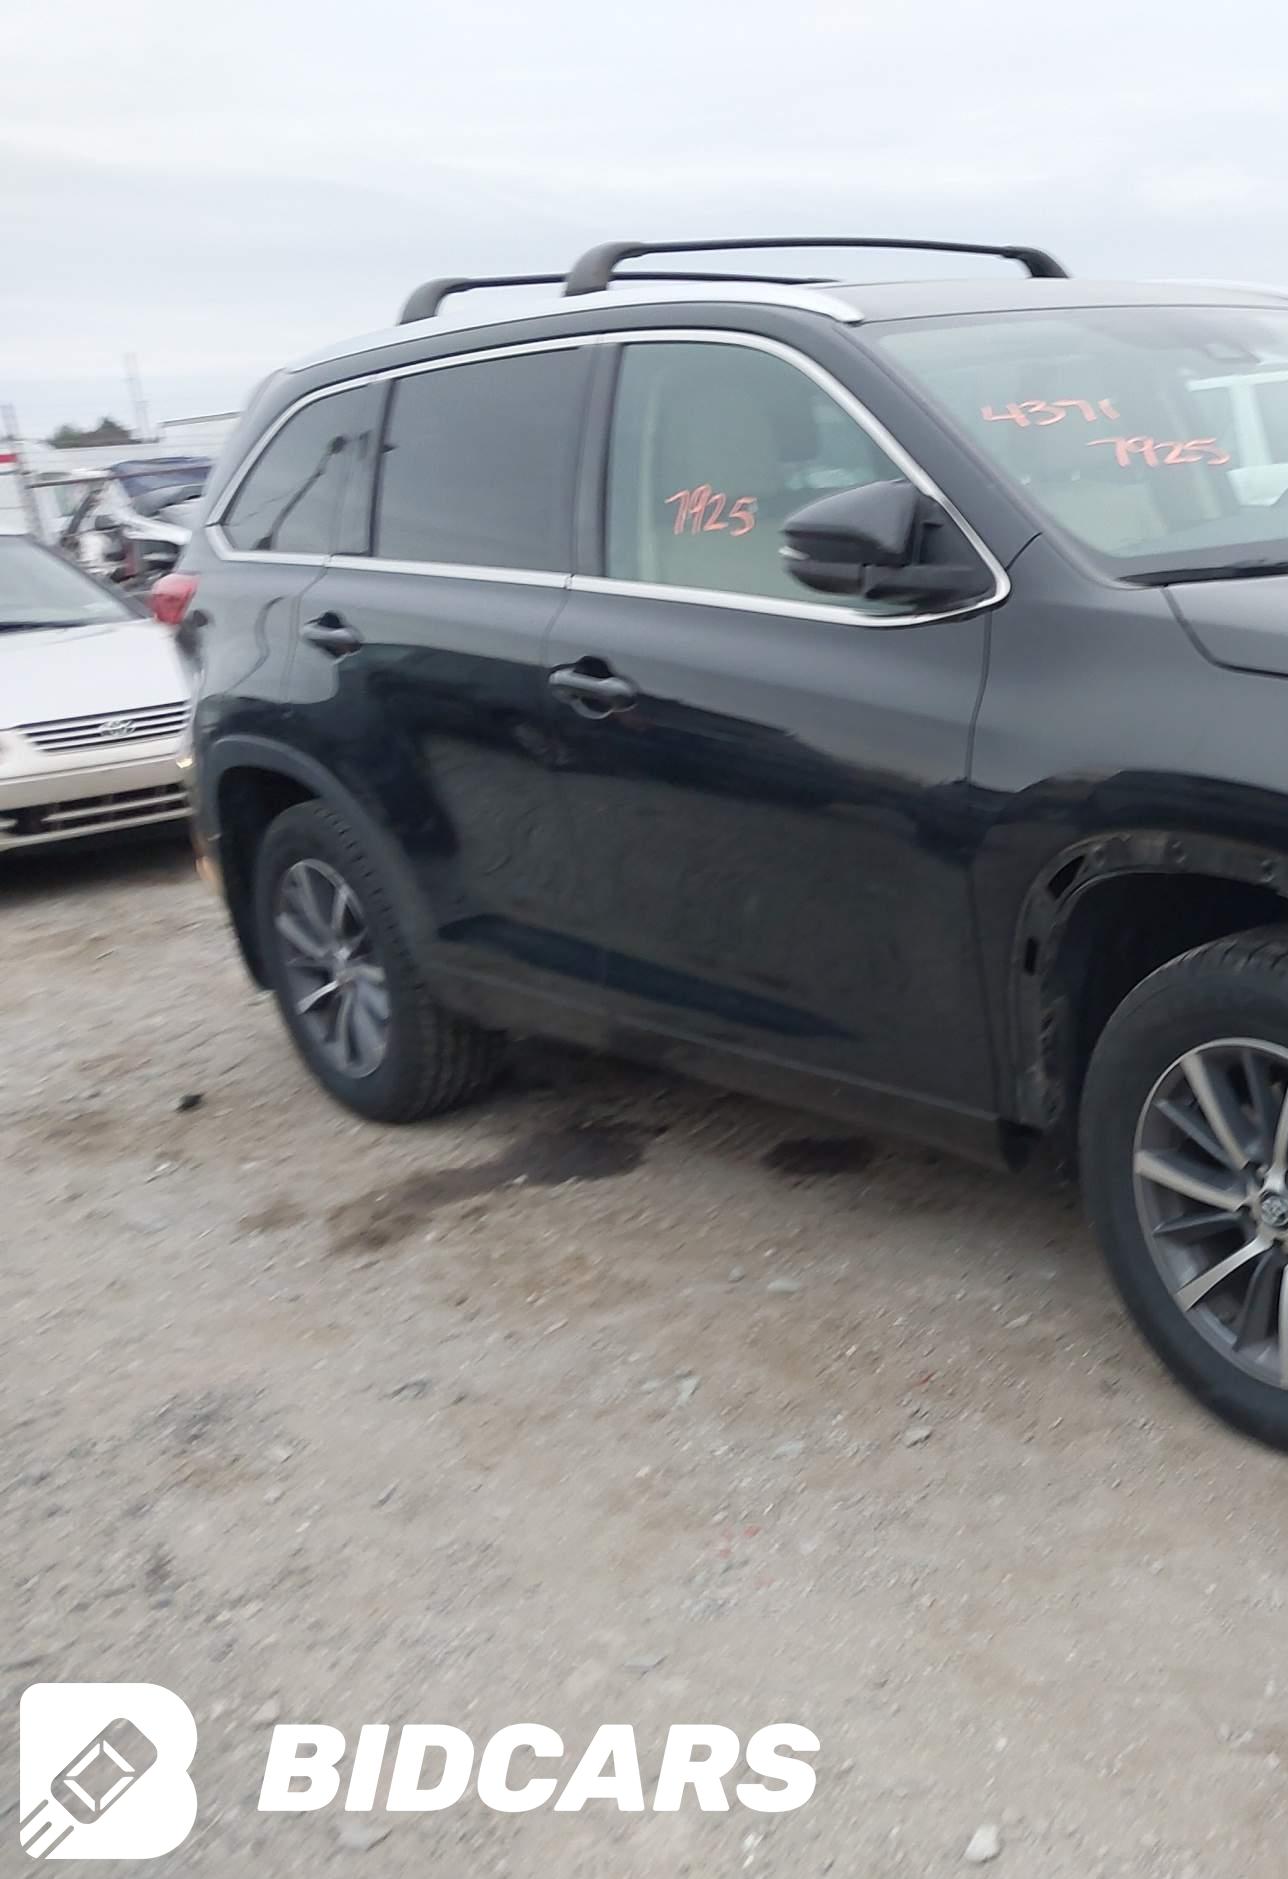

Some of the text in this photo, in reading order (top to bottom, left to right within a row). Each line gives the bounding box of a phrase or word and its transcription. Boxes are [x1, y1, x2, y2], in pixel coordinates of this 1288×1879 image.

[980, 398, 1121, 427] 4371
[1085, 436, 1231, 467] 7925
[664, 483, 758, 536] 7925
